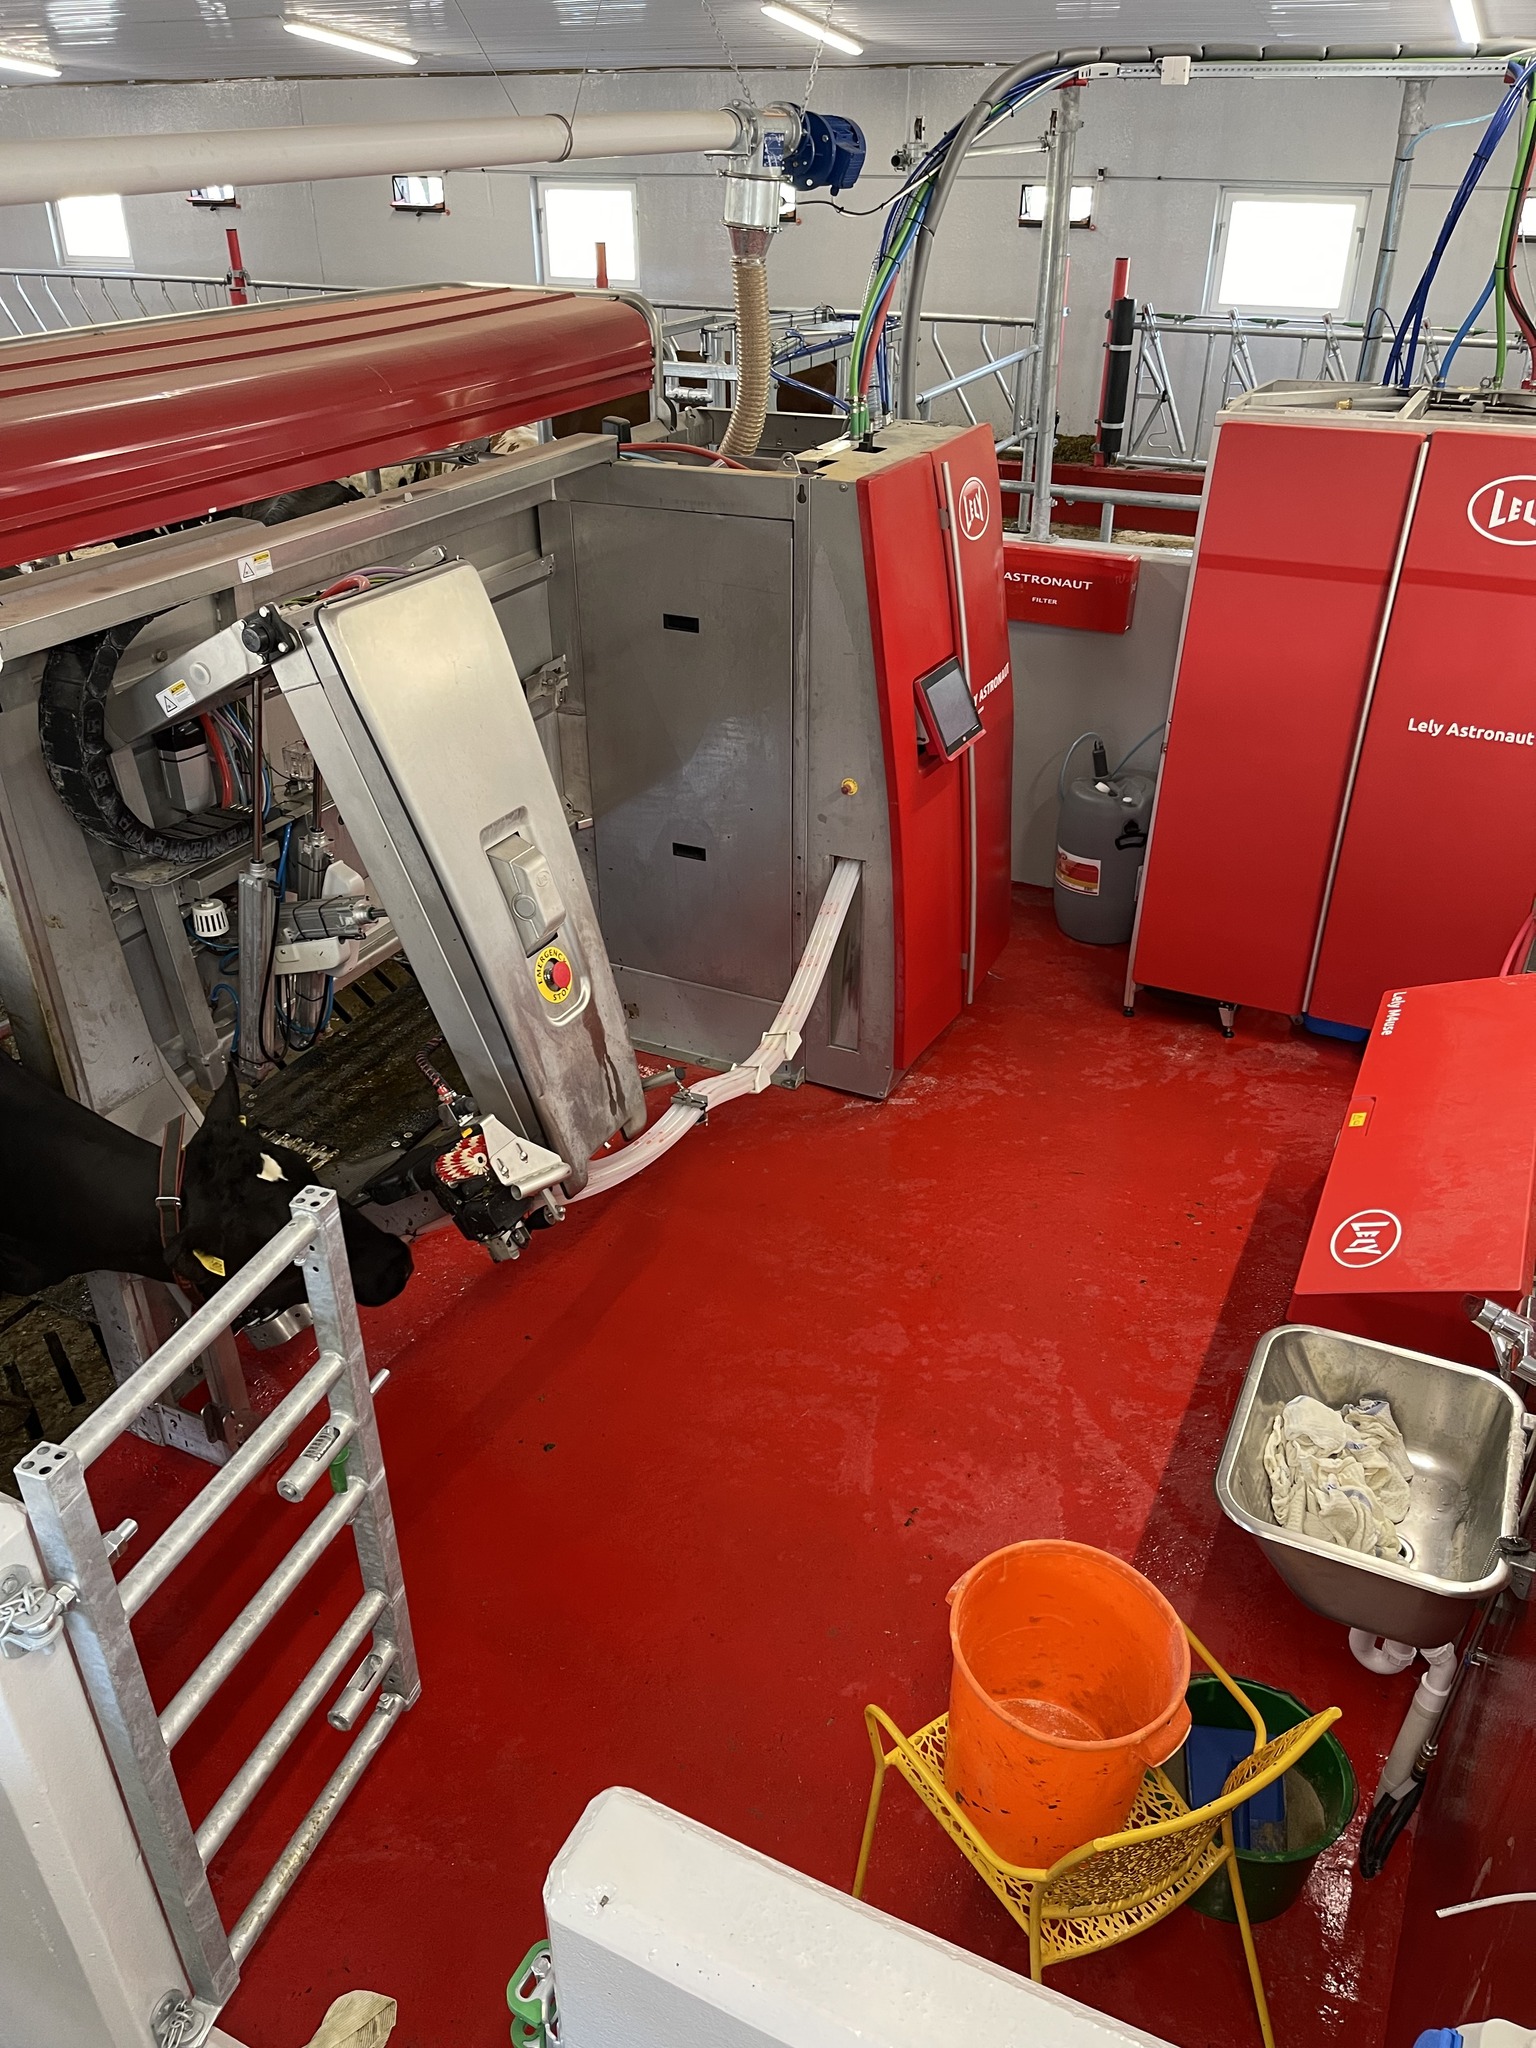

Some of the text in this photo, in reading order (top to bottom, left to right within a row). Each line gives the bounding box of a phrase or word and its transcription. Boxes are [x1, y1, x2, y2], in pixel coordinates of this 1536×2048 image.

[963, 485, 984, 533] LELY
[1488, 488, 1536, 529] LEL
[1003, 571, 1093, 591] ASTRONAUT
[1031, 596, 1058, 605] FILTER
[1407, 717, 1536, 746] Lely Astronaut
[552, 985, 569, 1001] STO
[1386, 991, 1408, 1009] Lely
[1343, 1221, 1391, 1255] LELY
